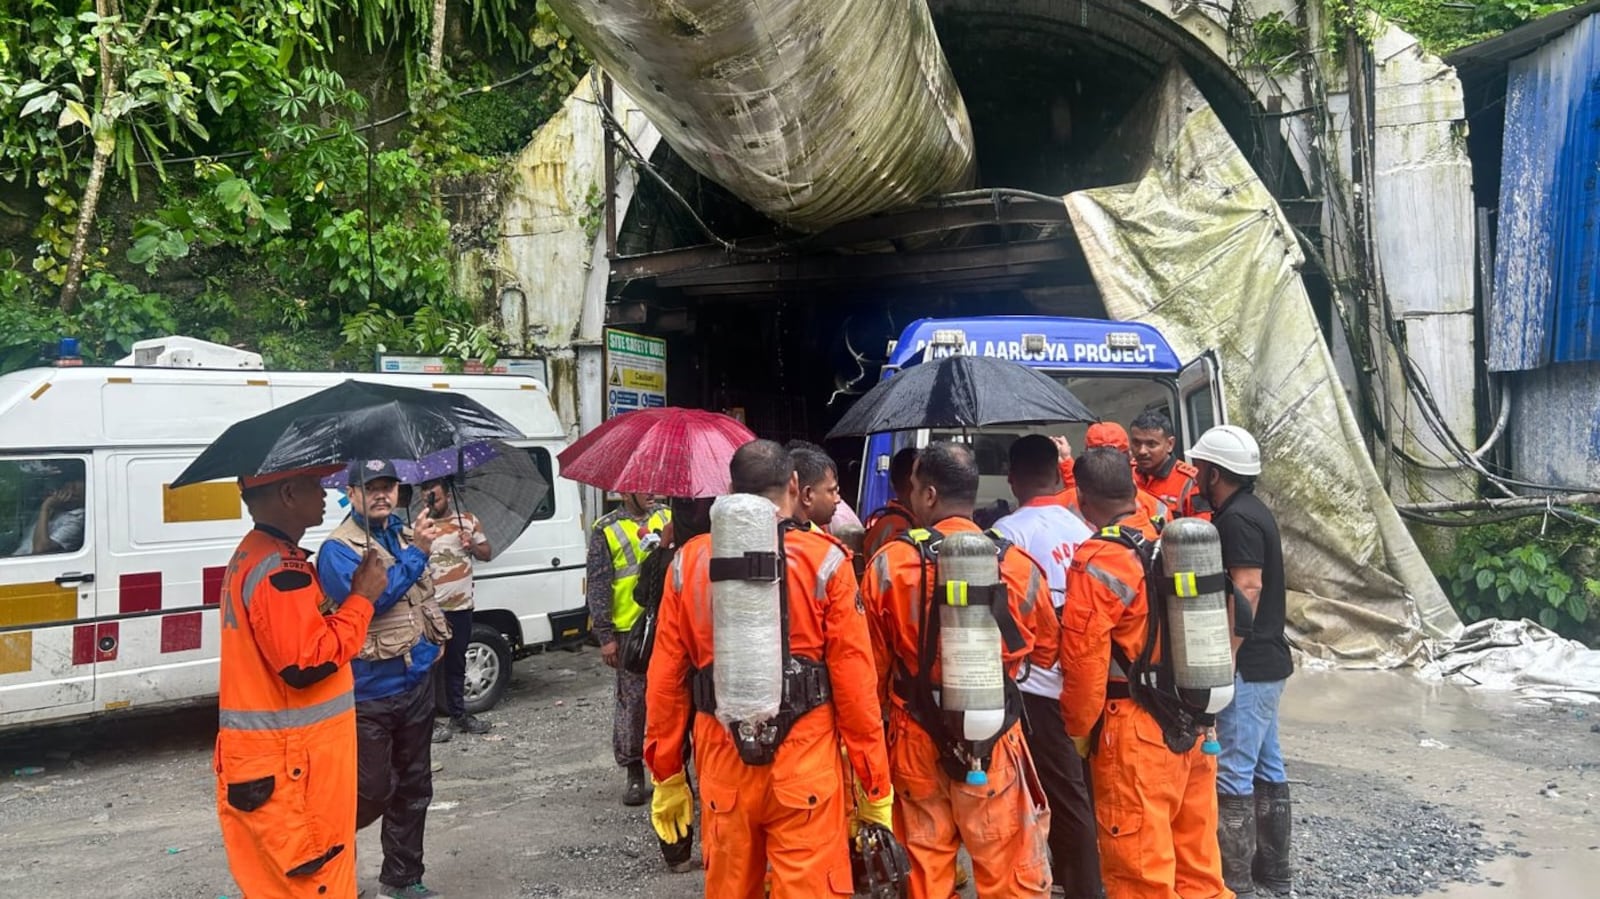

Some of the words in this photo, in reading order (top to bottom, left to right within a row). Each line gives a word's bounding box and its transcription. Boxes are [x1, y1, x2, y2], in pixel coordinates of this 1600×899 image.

[610, 333, 625, 350] SITE
[625, 336, 649, 355] SAFETY
[1074, 343, 1156, 362] PROJECT
